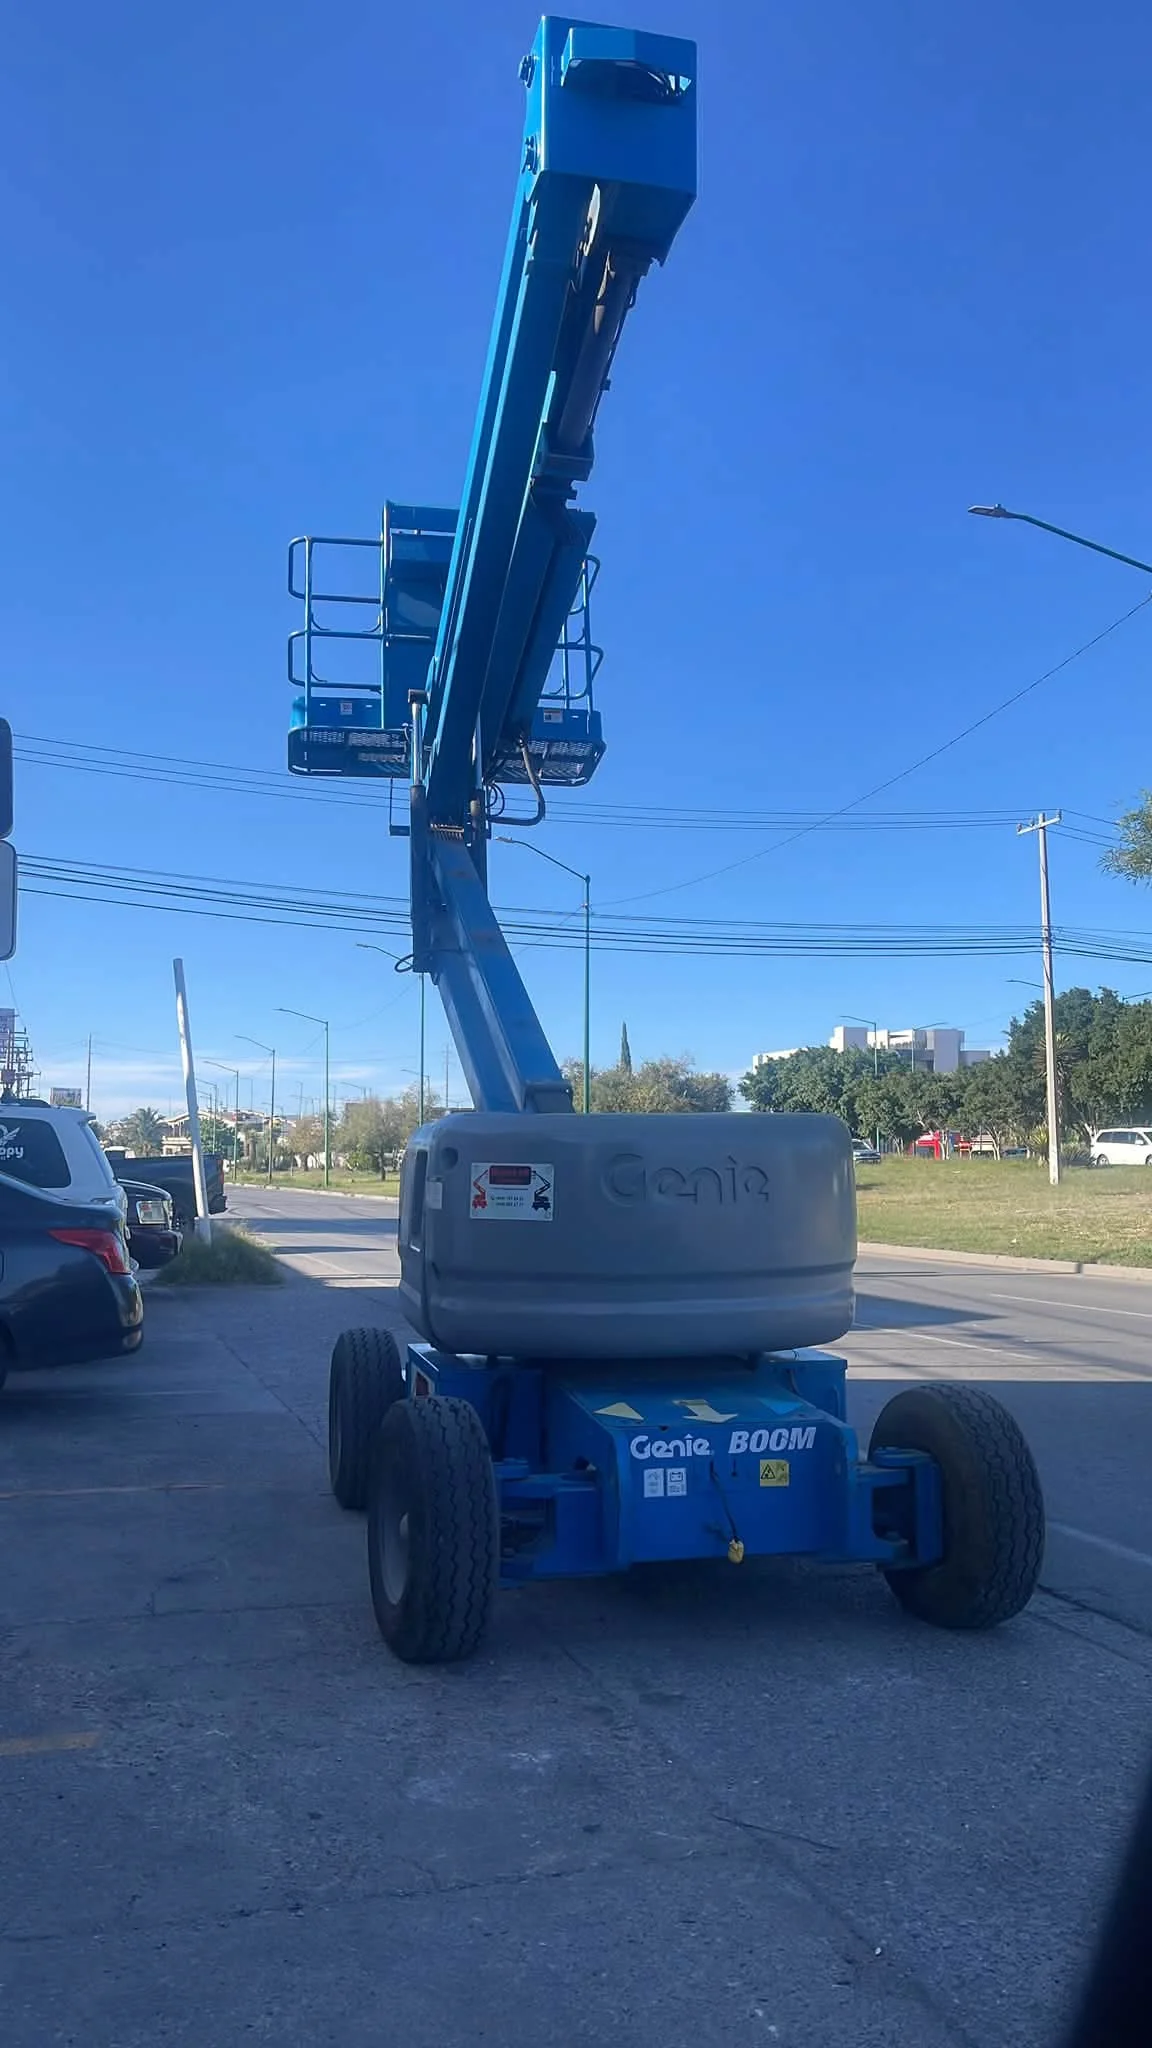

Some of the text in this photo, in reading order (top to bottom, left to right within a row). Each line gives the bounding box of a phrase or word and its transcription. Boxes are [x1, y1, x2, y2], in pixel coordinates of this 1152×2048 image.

[601, 1153, 769, 1206] Genie
[630, 1427, 816, 1460] Genie BOOM
